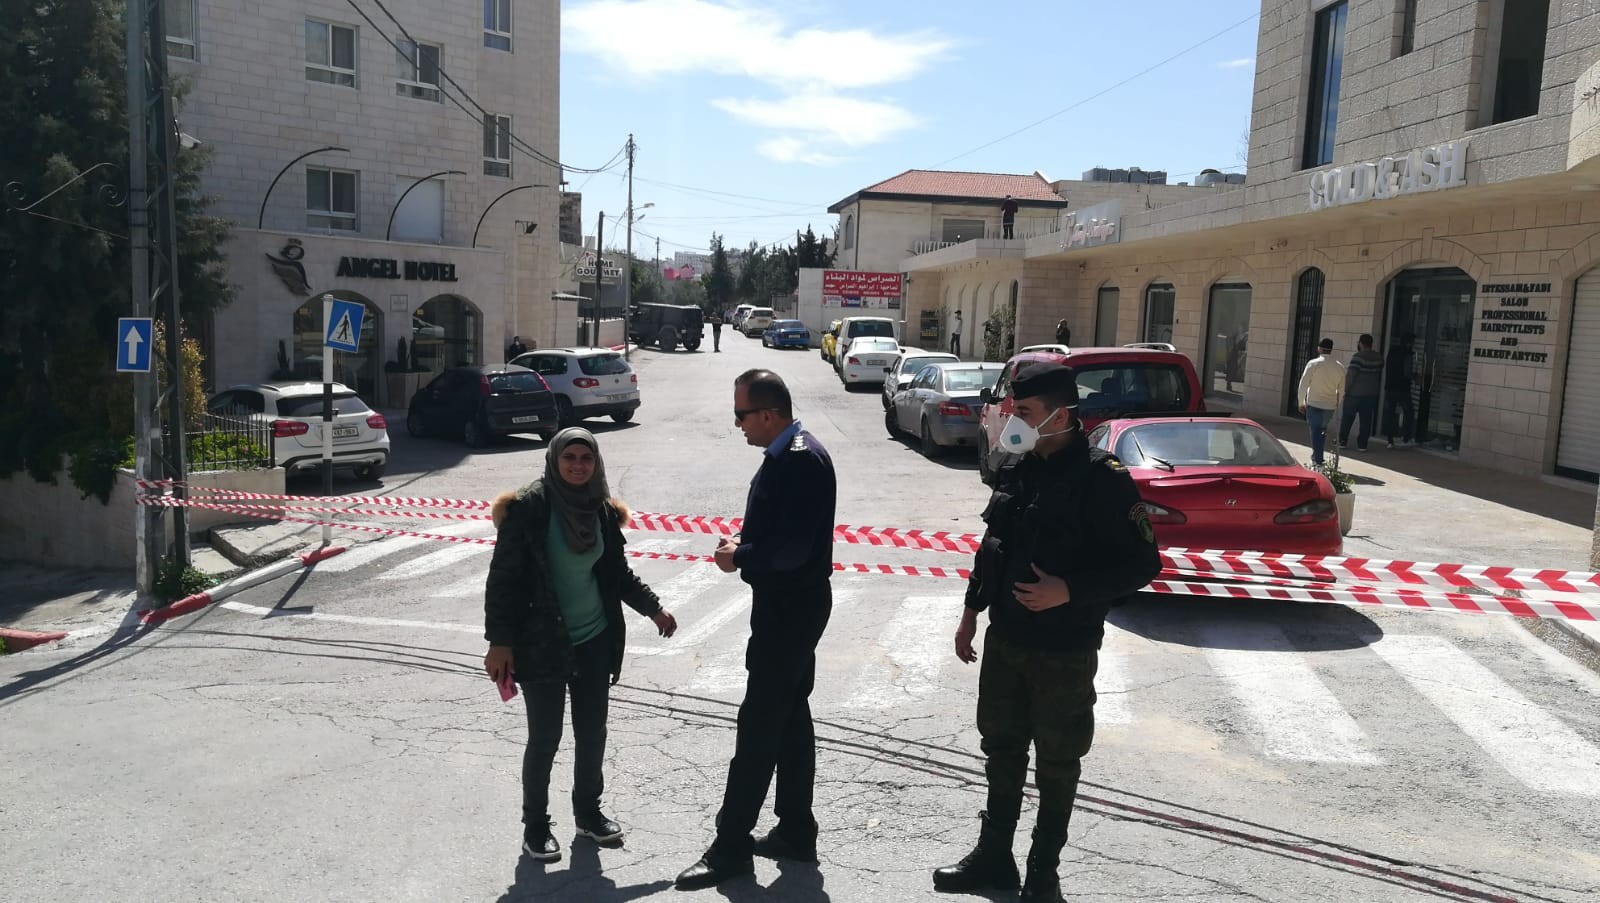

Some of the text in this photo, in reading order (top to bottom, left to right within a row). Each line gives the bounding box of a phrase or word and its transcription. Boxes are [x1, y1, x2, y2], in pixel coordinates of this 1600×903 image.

[336, 256, 458, 282] ANGEL HOTEL
[576, 268, 619, 276] GOUMET
[1500, 297, 1529, 307] SALON
[1481, 310, 1548, 321] PROFESSIONAL
[1480, 322, 1545, 335] HAIRSTYLISTS
[1500, 337, 1519, 347] AND
